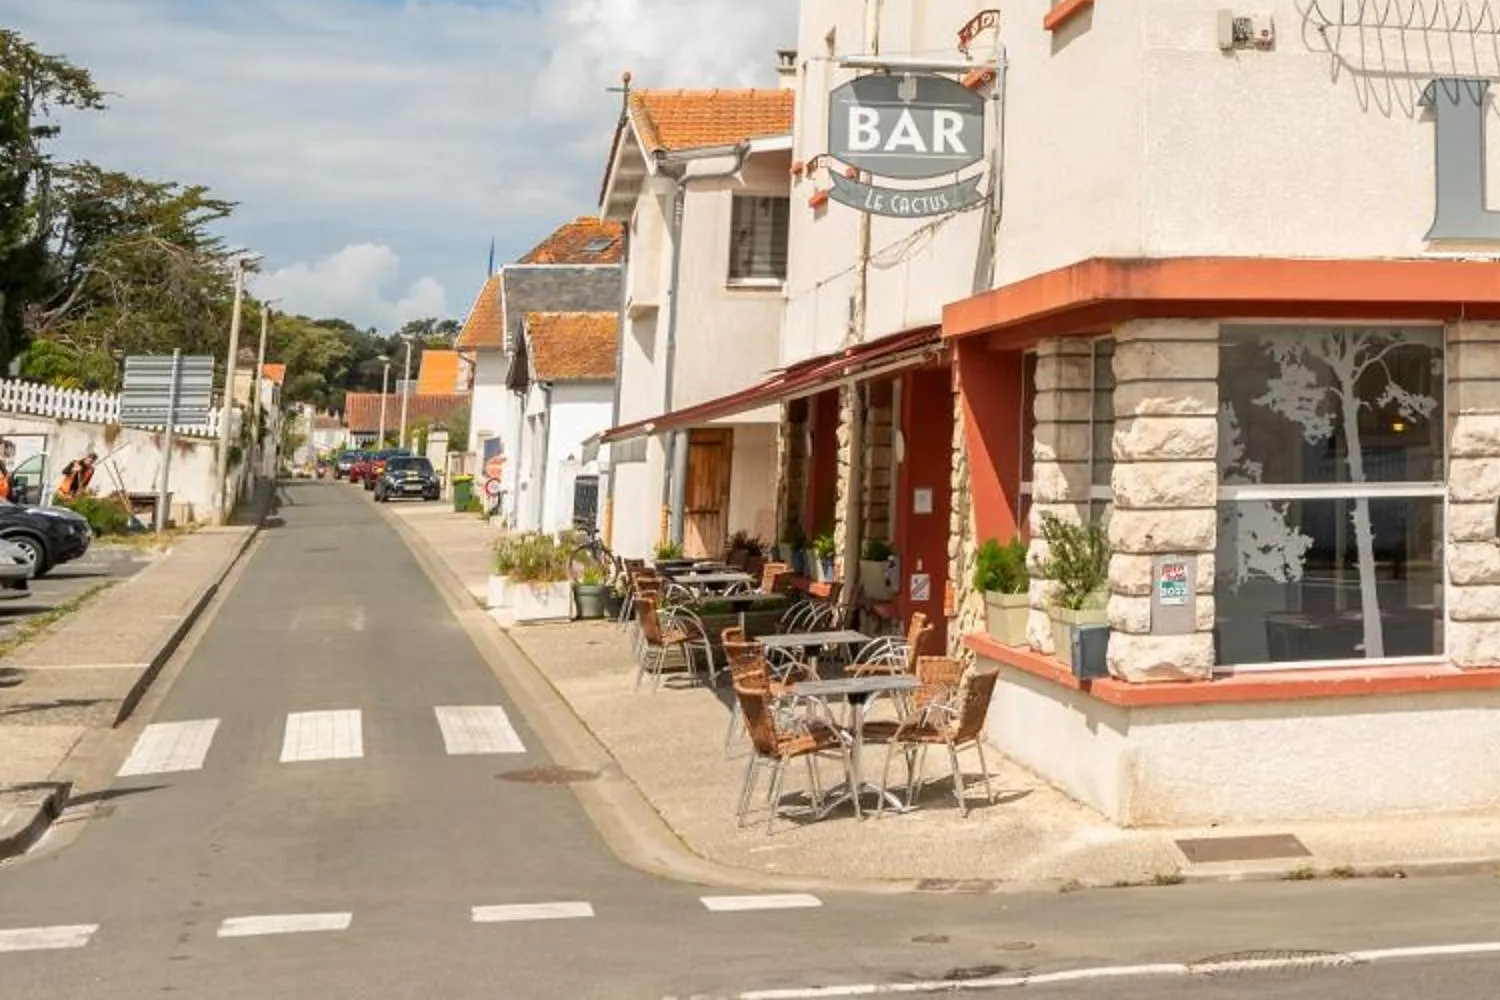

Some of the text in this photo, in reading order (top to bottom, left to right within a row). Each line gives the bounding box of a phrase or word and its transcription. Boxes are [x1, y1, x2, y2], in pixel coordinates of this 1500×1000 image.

[848, 106, 967, 153] BAR
[864, 189, 949, 214] LE CACTUS
